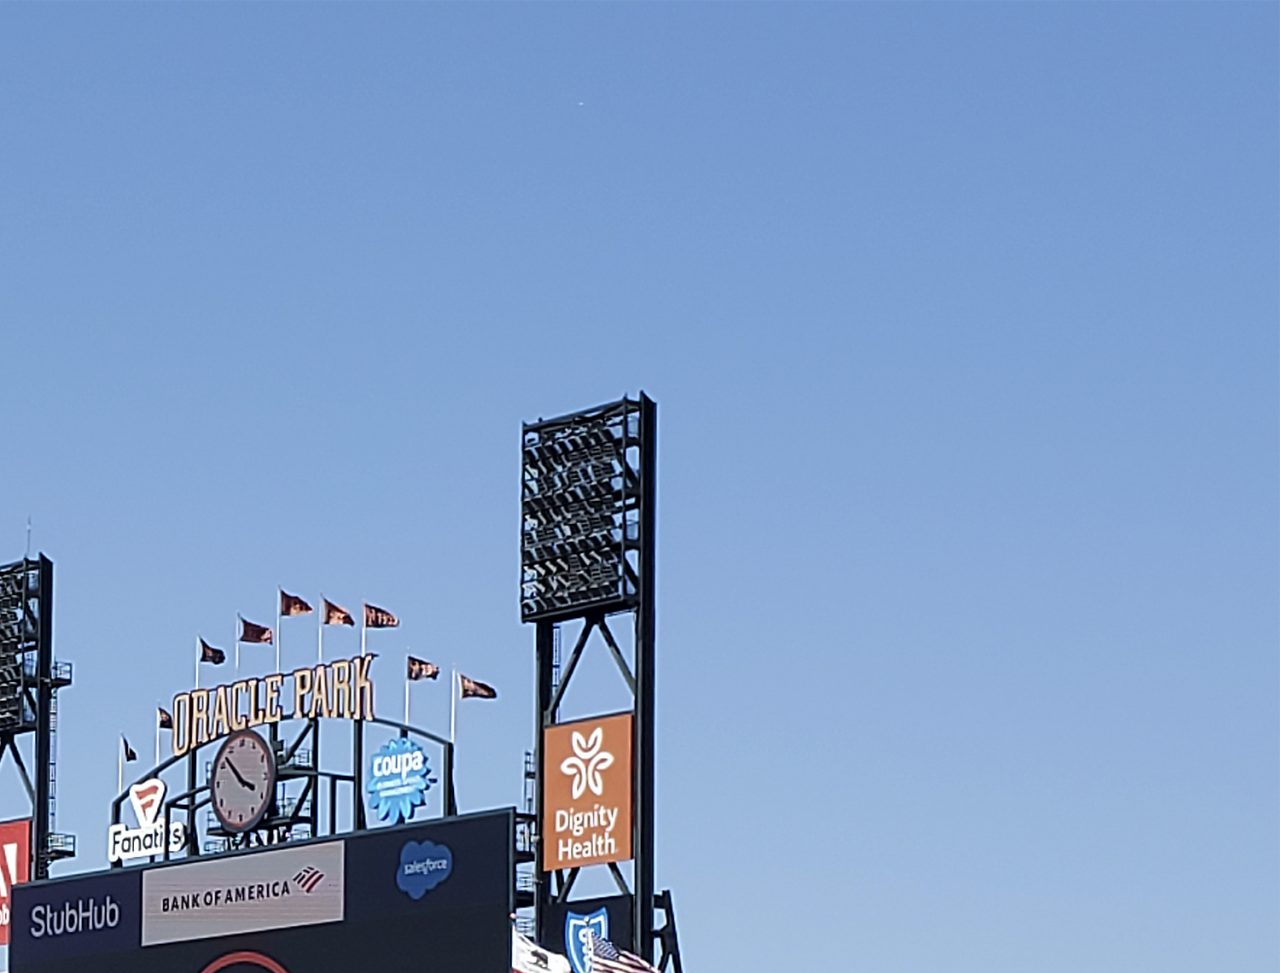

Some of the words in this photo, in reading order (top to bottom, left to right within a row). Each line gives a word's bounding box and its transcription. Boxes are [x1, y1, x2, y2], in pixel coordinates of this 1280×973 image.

[173, 673, 283, 756] ORACLE
[293, 652, 377, 722] PARK
[373, 751, 424, 780] coupa
[555, 804, 618, 836] Dignity
[112, 827, 181, 855] Fanatis
[558, 832, 616, 861] Health
[404, 858, 448, 875] salesforce
[162, 893, 200, 912] BANK
[203, 890, 222, 907] OF
[224, 881, 290, 904] AMERICA
[31, 896, 119, 938] StubHub
